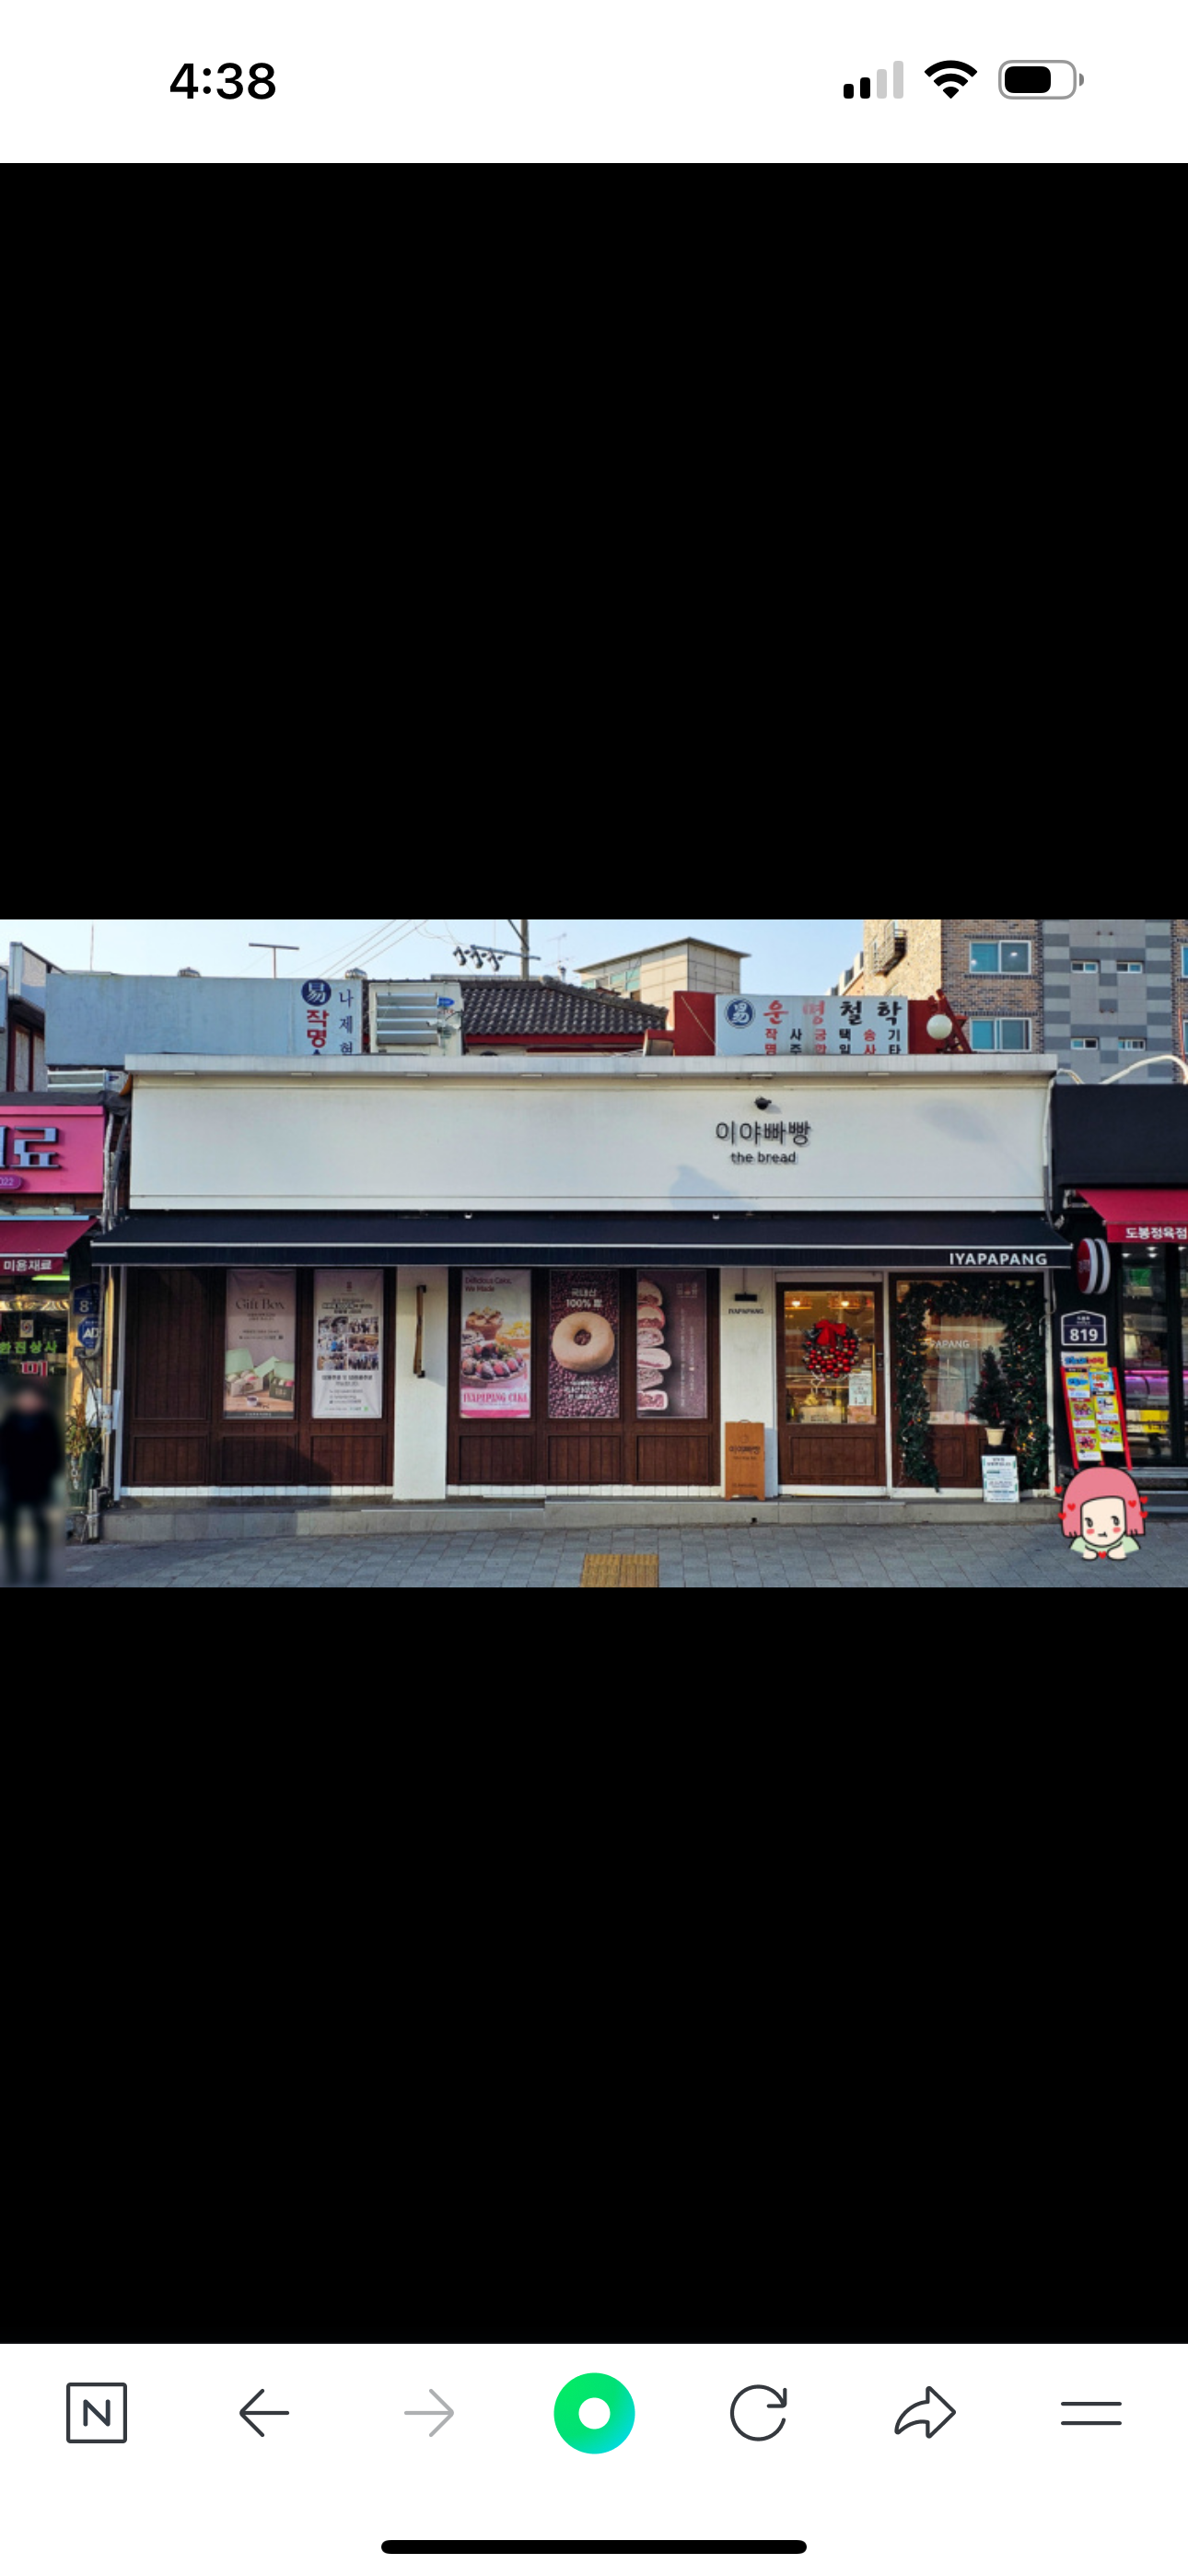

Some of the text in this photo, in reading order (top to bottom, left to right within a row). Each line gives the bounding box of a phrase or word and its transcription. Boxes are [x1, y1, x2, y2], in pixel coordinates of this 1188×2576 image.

[307, 1009, 330, 1056] 작명
[716, 1120, 812, 1146] 이야빠빵
[731, 1152, 797, 1164] the bread
[1125, 1226, 1187, 1240] 도봉정육점
[4, 1259, 52, 1272] 미용재료
[949, 1253, 1048, 1266] IYAPAPANG
[1070, 1329, 1099, 1341] 819
